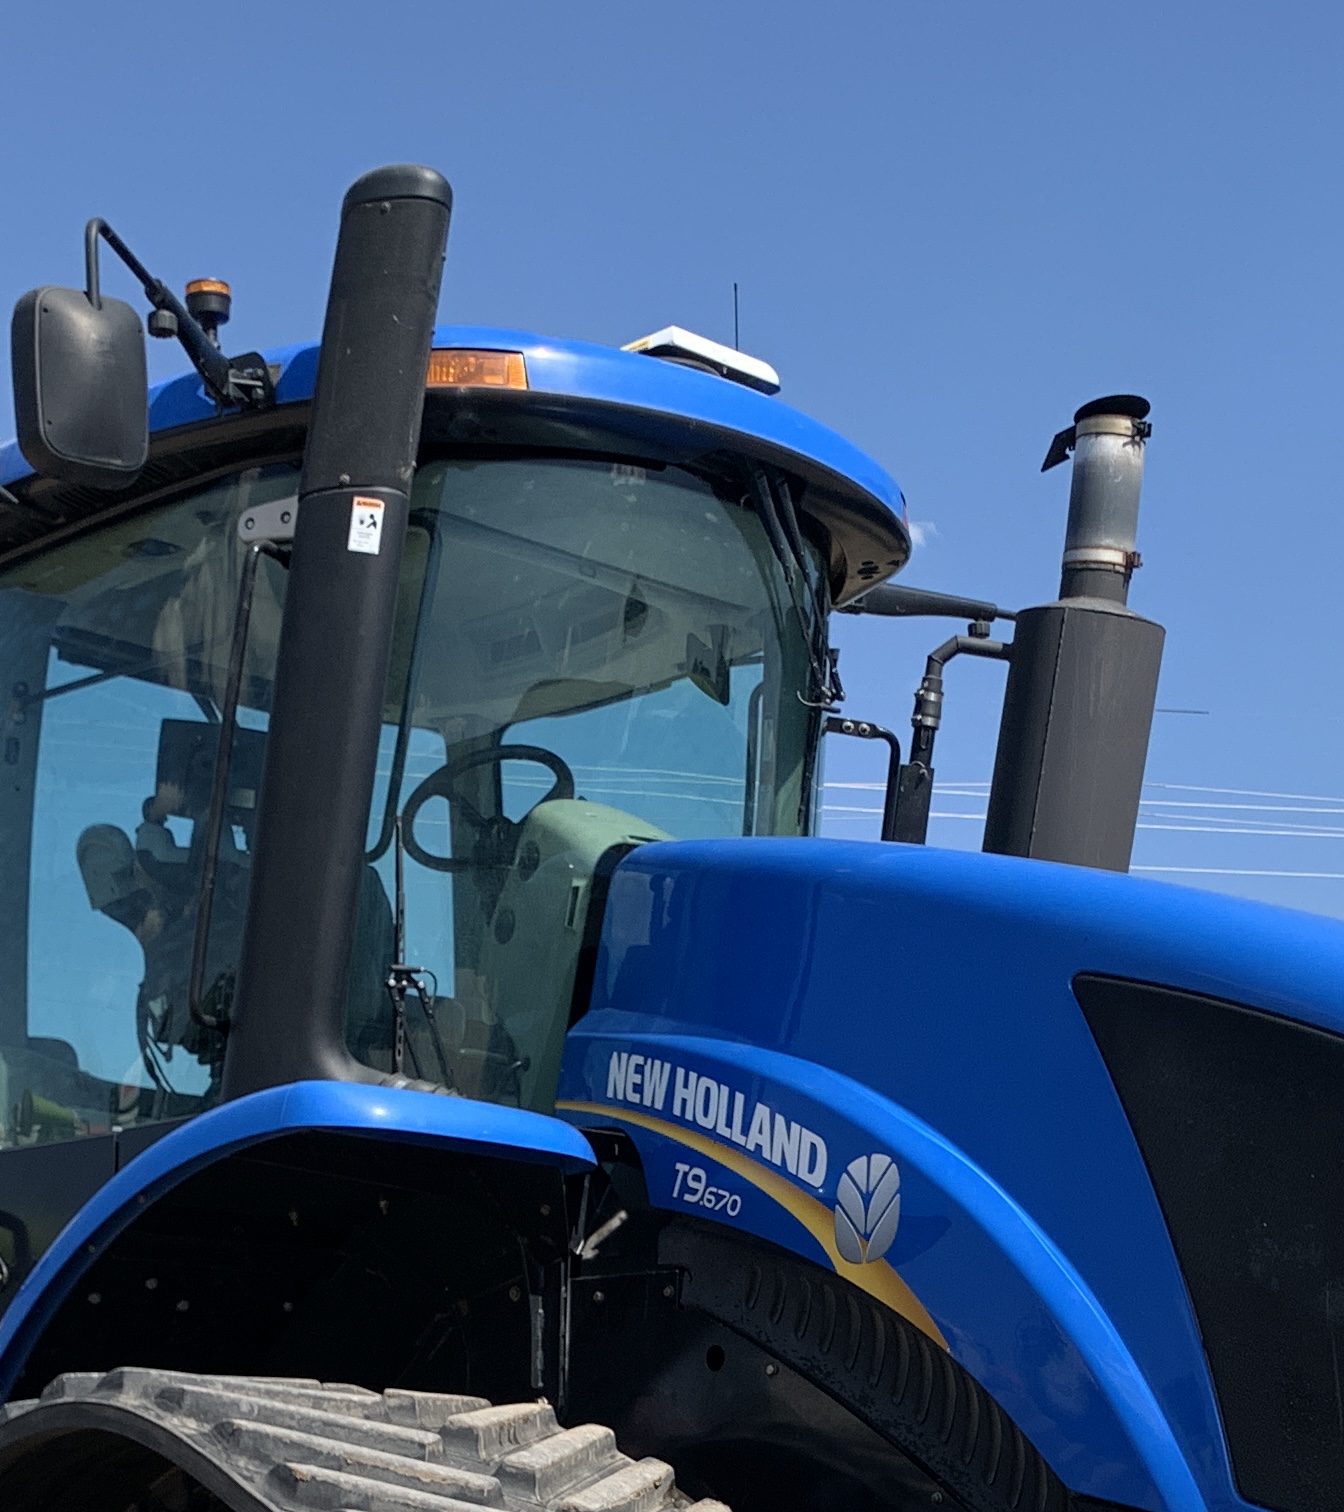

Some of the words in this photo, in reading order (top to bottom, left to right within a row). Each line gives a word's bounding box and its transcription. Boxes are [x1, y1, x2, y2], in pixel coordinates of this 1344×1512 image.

[606, 1051, 672, 1111] NEW
[673, 1066, 828, 1189] HOLLAND
[673, 1162, 742, 1218] T9.670
